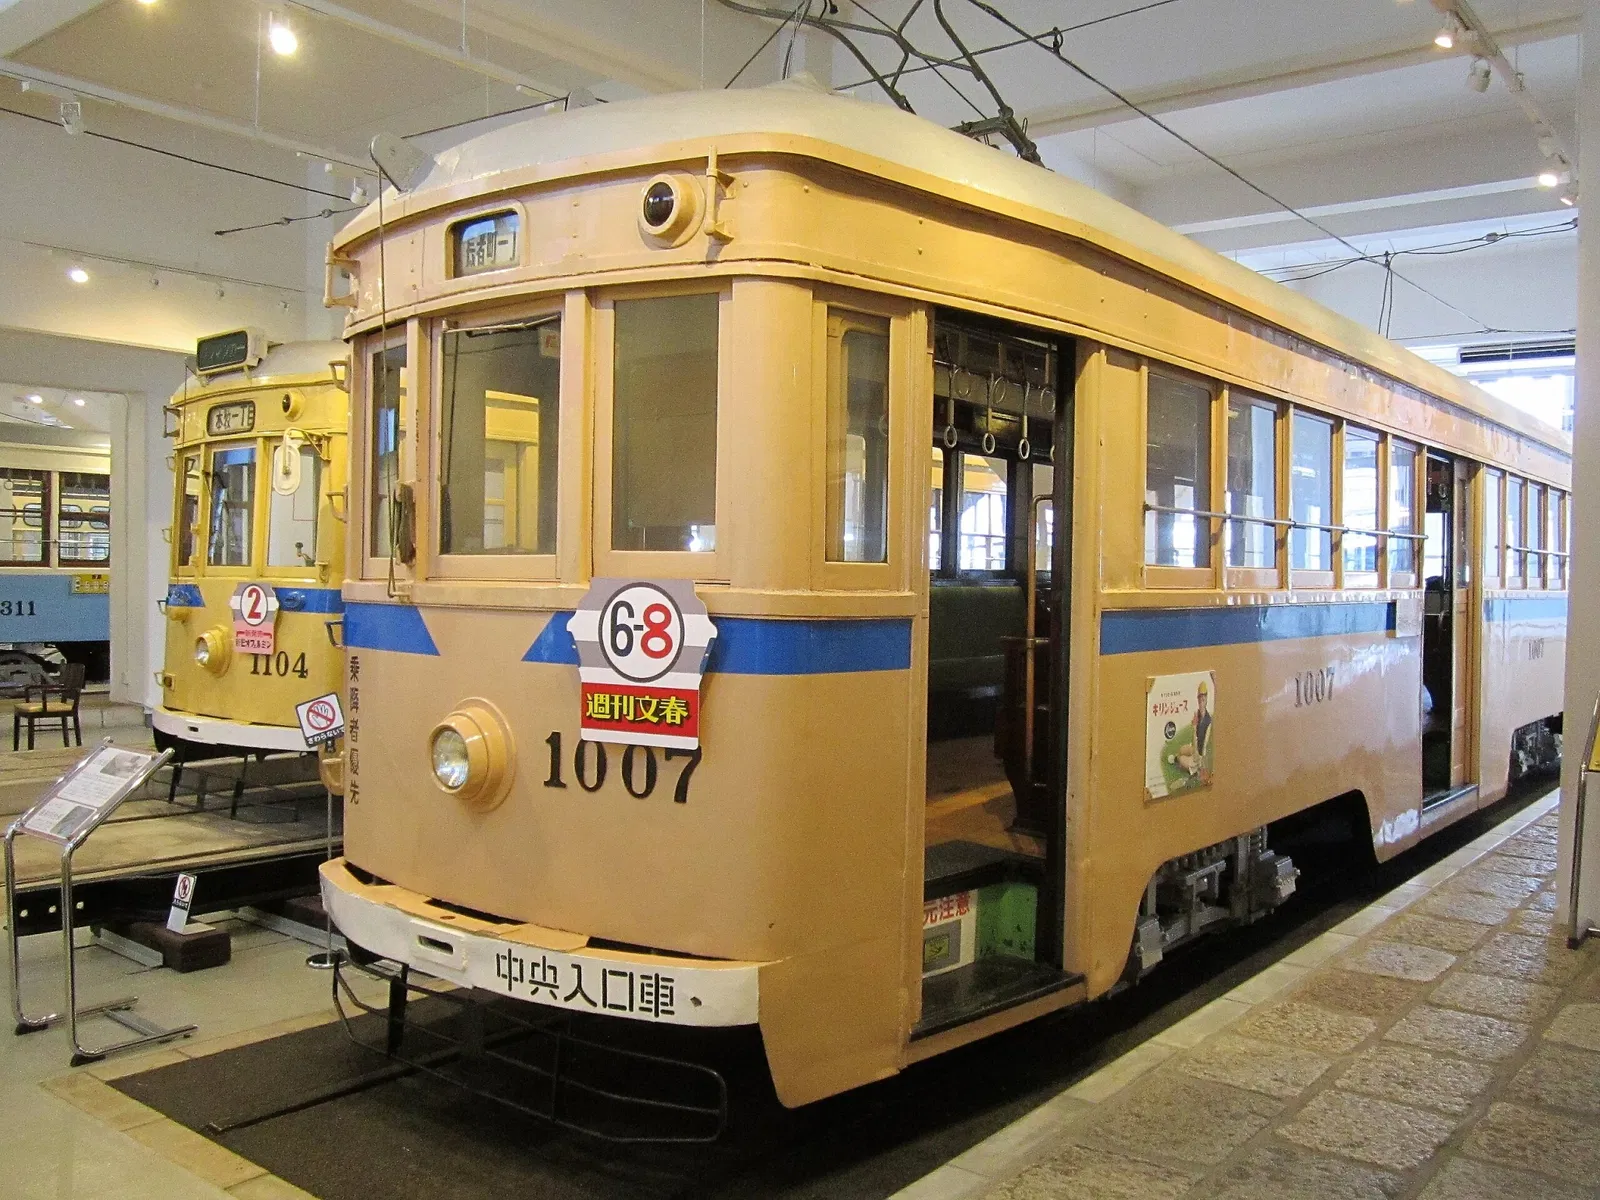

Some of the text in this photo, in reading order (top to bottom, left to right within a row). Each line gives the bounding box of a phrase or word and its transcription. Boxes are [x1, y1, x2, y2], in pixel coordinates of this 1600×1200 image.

[247, 587, 262, 620] 2
[610, 600, 673, 660] 6-8
[250, 650, 309, 679] 1104
[1294, 666, 1335, 708] 1007
[585, 692, 689, 726] 週刊文春
[543, 731, 702, 804] 1007
[496, 948, 675, 1019] 中央入口車
